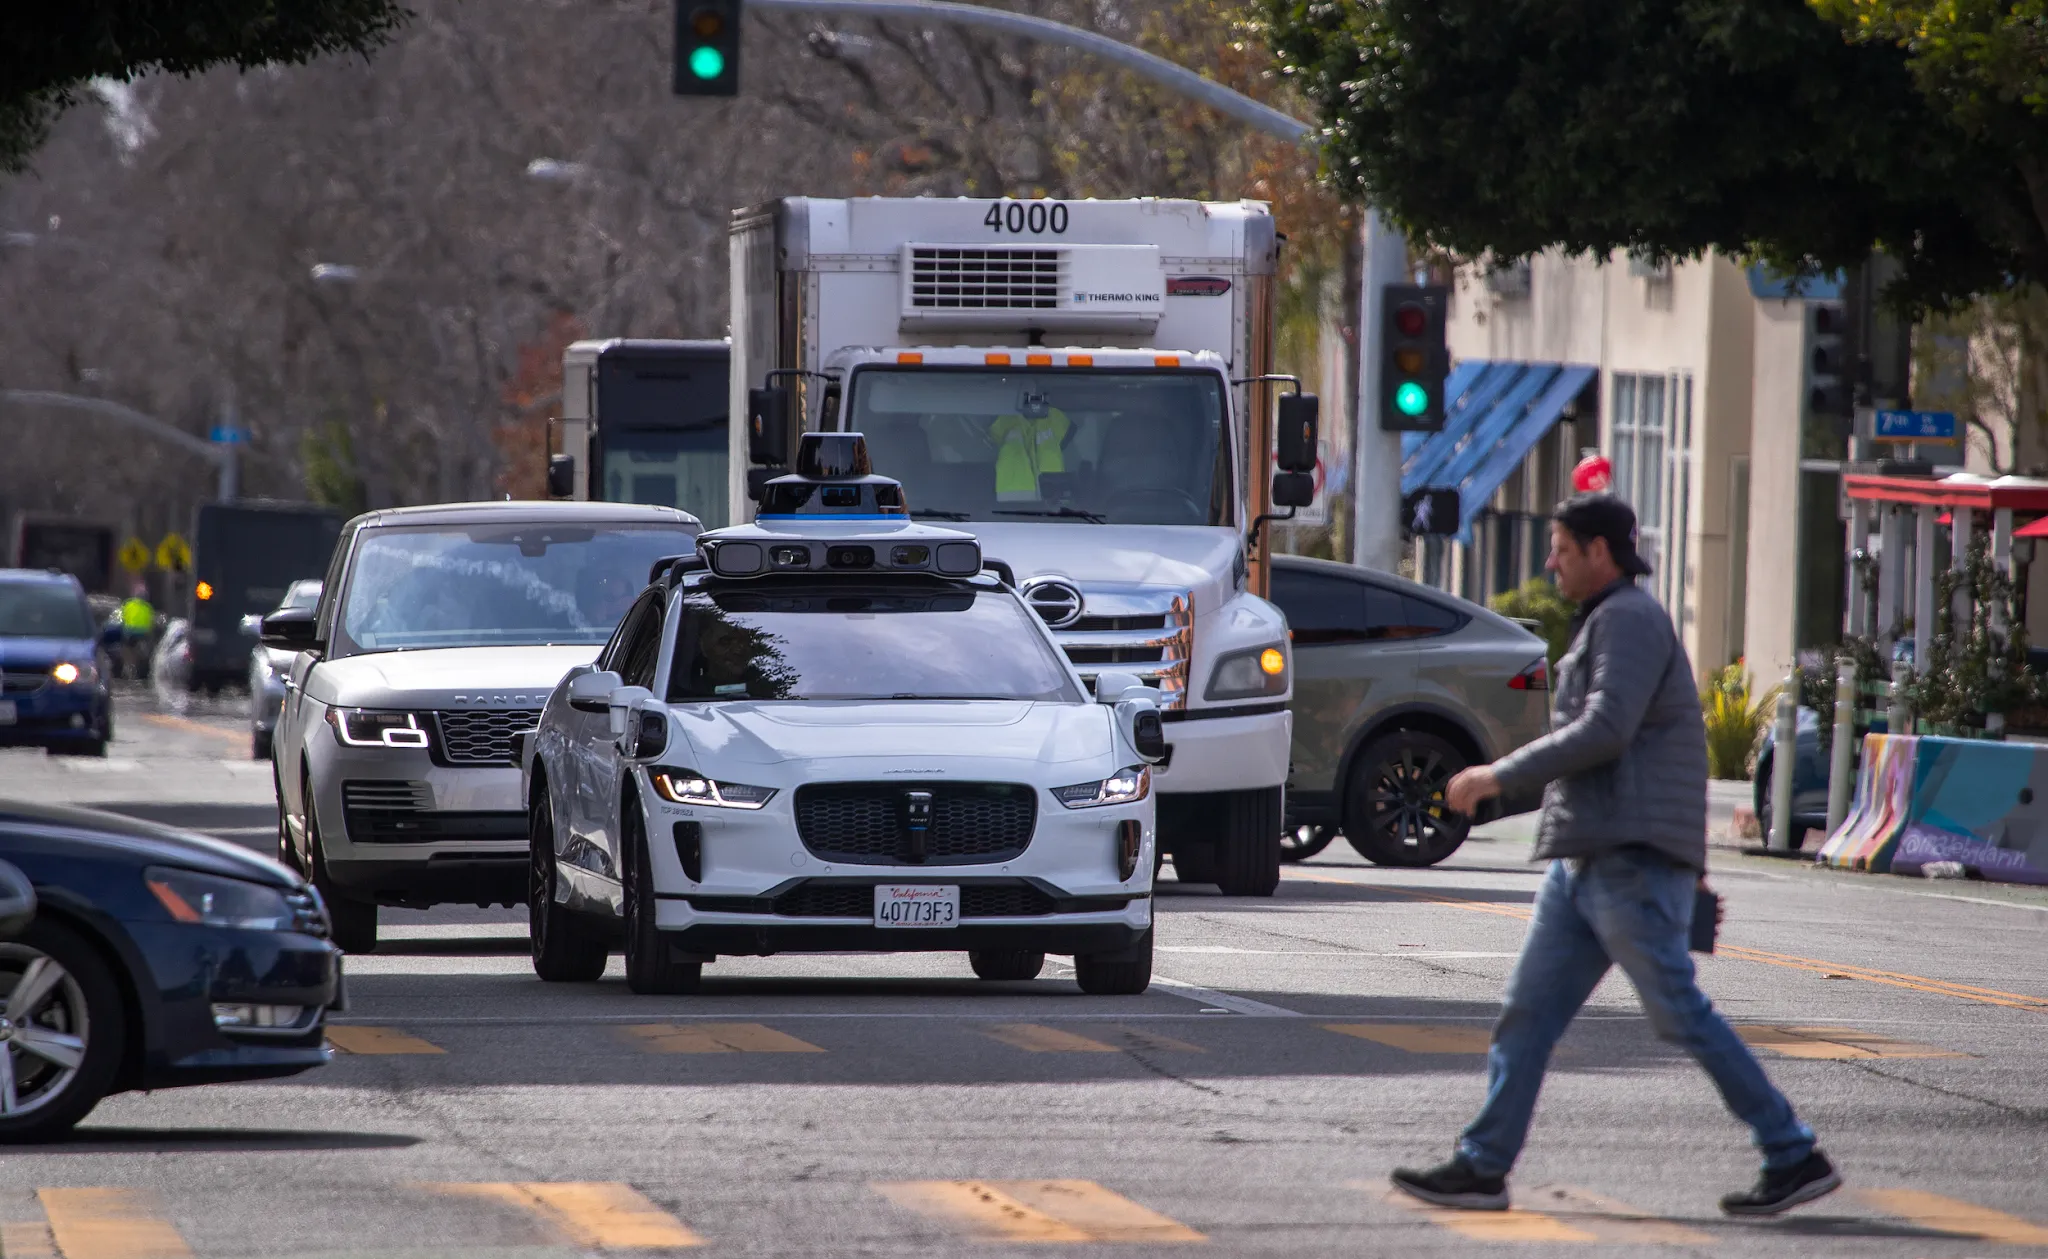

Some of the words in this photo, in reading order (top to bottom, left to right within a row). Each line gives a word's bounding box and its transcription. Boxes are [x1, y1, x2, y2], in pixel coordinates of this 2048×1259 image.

[984, 202, 1069, 234] 4000
[1088, 293, 1133, 301] THERMO
[1135, 293, 1160, 301] KING
[454, 695, 547, 704] RANGE
[892, 887, 944, 900] California
[880, 901, 953, 922] 40773F3
